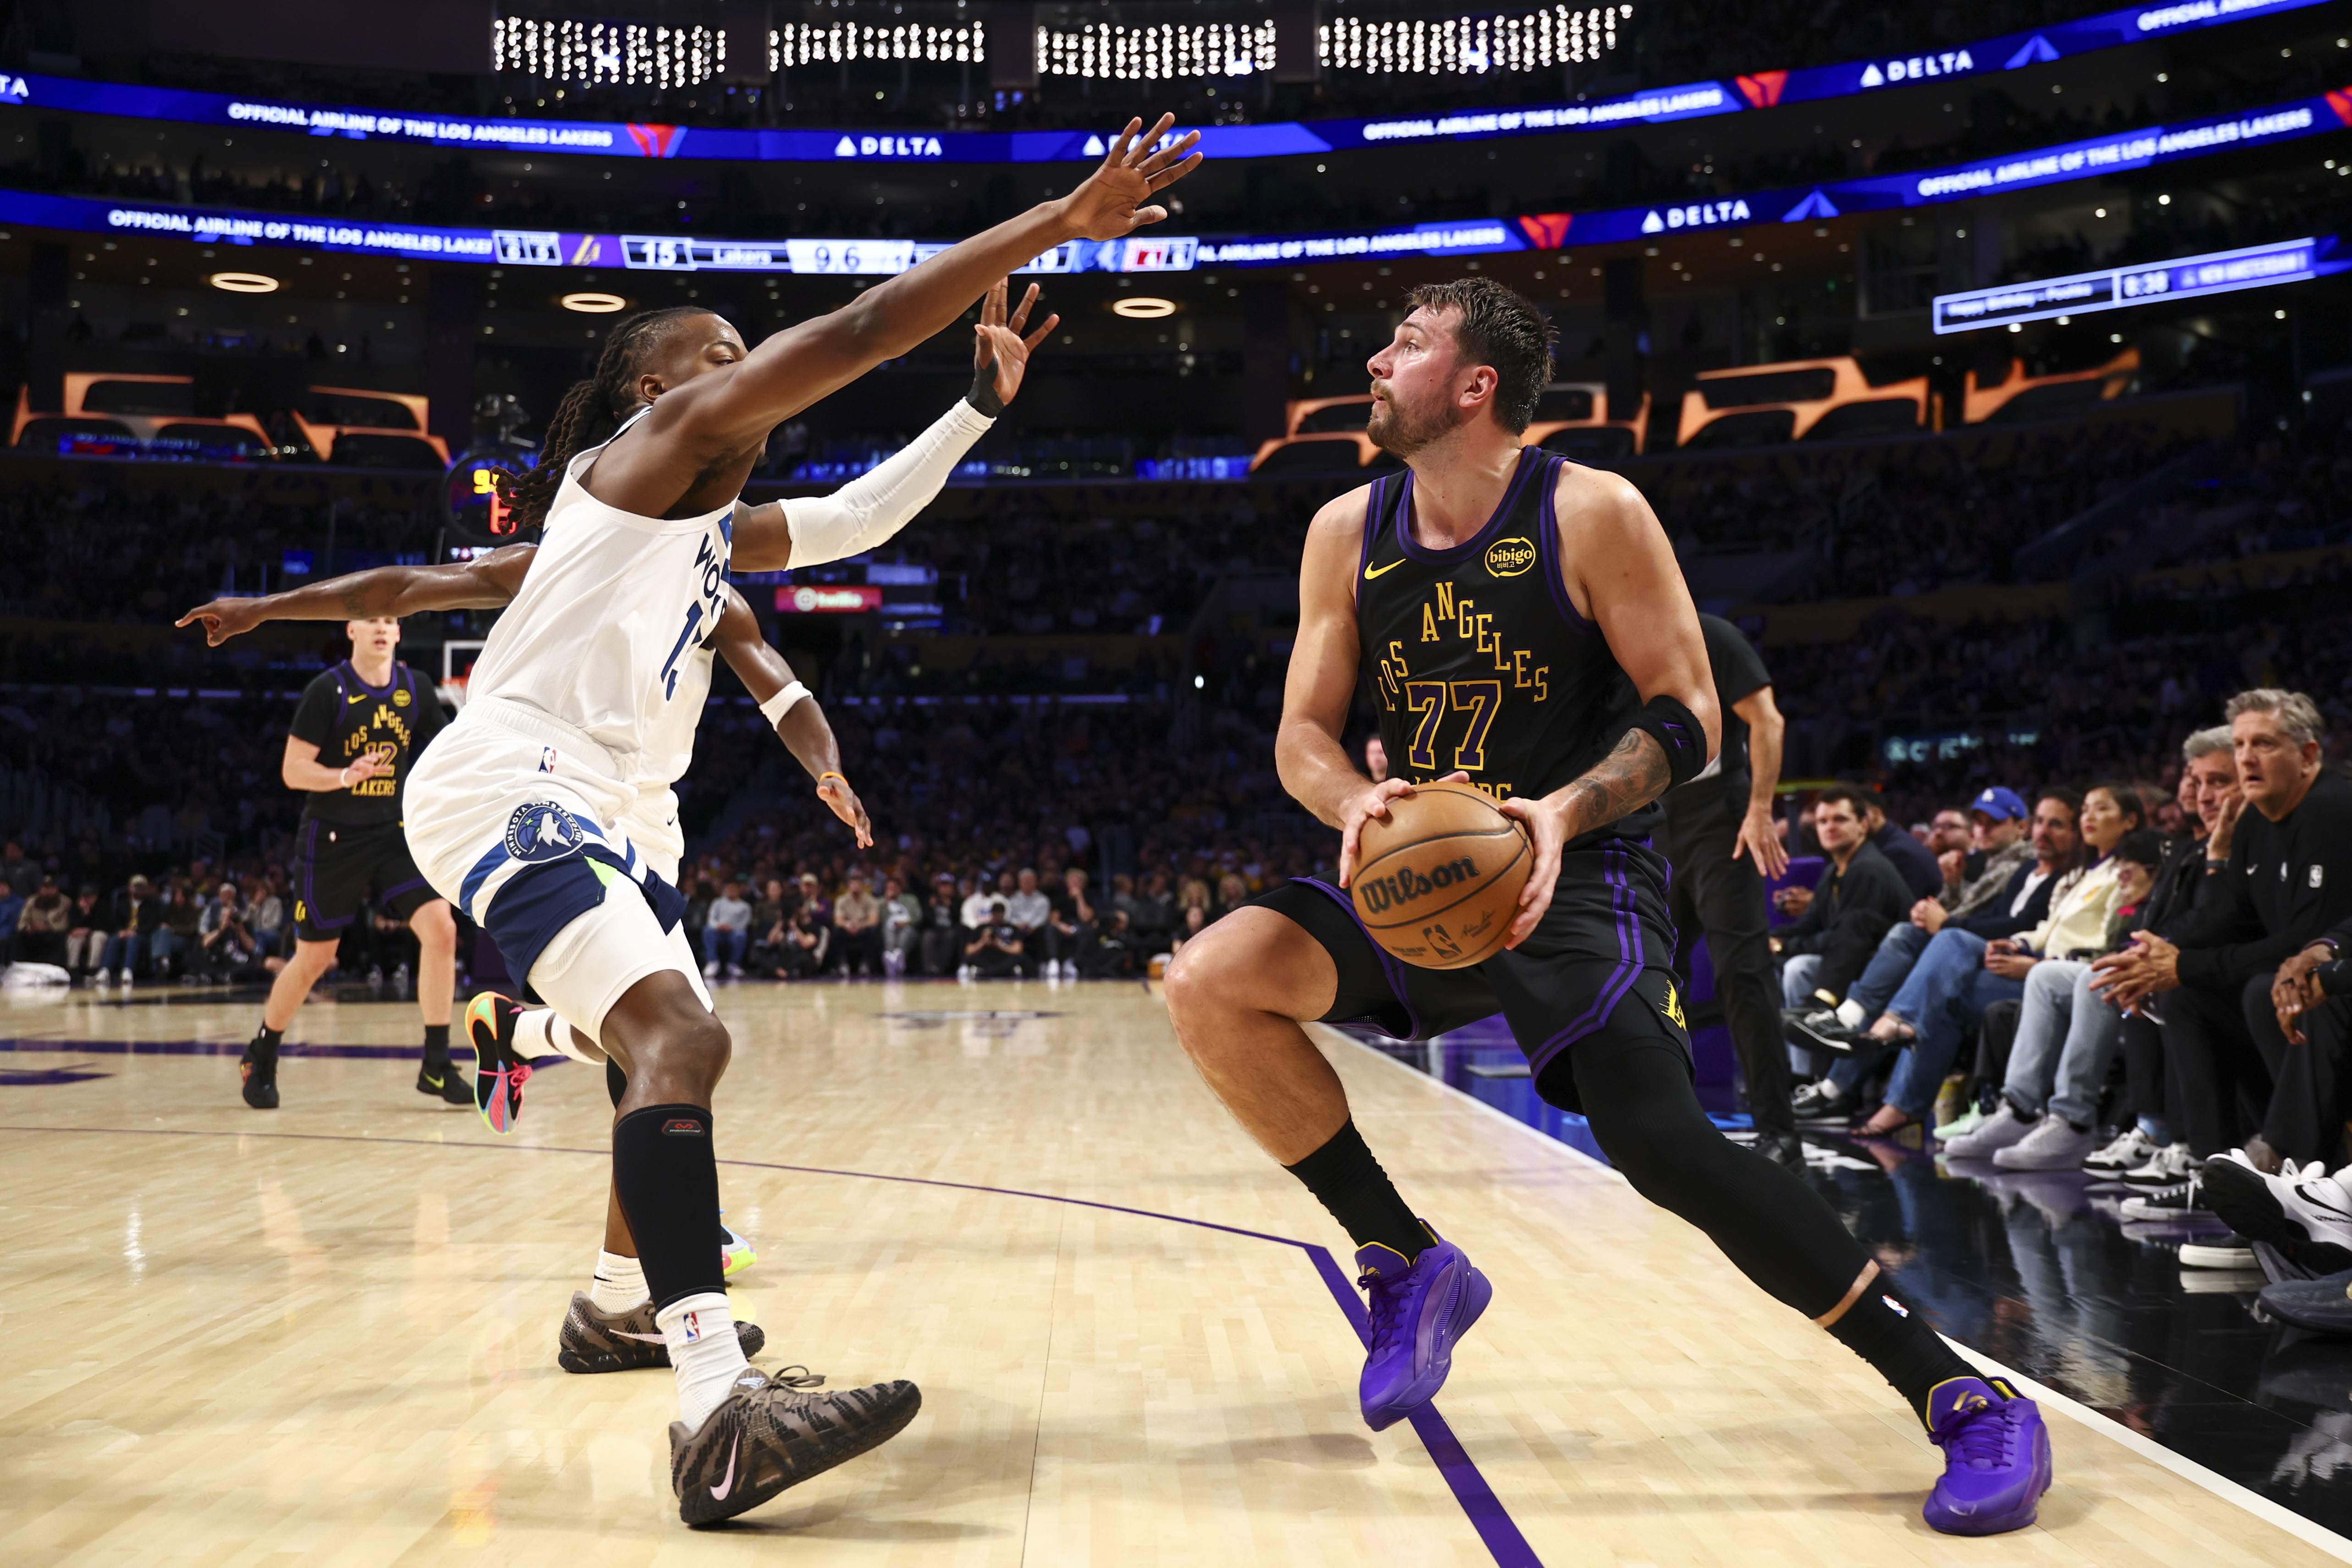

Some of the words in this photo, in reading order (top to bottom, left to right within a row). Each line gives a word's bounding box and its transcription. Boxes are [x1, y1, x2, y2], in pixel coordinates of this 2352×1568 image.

[1888, 51, 1972, 81] DELTA
[229, 103, 308, 125] OFFICIAL
[310, 111, 376, 132] AIRLINE
[377, 117, 402, 133] OF
[403, 120, 437, 137] THE
[437, 123, 472, 140] LOS
[473, 126, 549, 143] ANGELES
[550, 129, 613, 147] LAKERS
[1363, 121, 1435, 140] OFFICIAL
[1435, 115, 1498, 134] AIRLINE
[1498, 113, 1523, 129] OF
[1524, 110, 1555, 127] THE
[1555, 108, 1589, 125] LOS
[1590, 98, 1660, 122] ANGELES
[1661, 89, 1723, 113] LAKERS
[861, 137, 941, 155] DELTA
[1918, 170, 1994, 196] OFFICIAL
[1995, 156, 2060, 183] AIRLINE
[2060, 151, 2085, 171] OF
[2086, 144, 2121, 166] THE
[2121, 138, 2155, 160] LOS
[2156, 123, 2240, 153] ANGELES
[2240, 109, 2311, 138] LAKERS
[109, 210, 192, 231] OFFICIAL
[194, 217, 263, 237] AIRLINE
[264, 223, 291, 239] OF
[292, 225, 326, 242] THE
[328, 228, 363, 245] LOS
[364, 231, 443, 252] ANGELES
[1668, 201, 1749, 227] DELTA
[641, 240, 677, 268] 15
[713, 247, 772, 265] Lakers
[1280, 241, 1304, 258] OF
[1305, 239, 1335, 256] THE
[1335, 237, 1369, 254] LOS
[1369, 231, 1441, 252] ANGELES
[1442, 227, 1506, 247] LAKERS
[1490, 548, 1533, 565] bibigo
[1378, 640, 1408, 711] LOS
[1421, 581, 1549, 703] ANGELES
[344, 726, 368, 757] LOS
[373, 704, 409, 752] ANGELE
[1404, 680, 1501, 771] 77
[507, 807, 528, 857] MINNESOTA
[1359, 856, 1480, 914] Wilson
[569, 1305, 586, 1332] TWELVE
